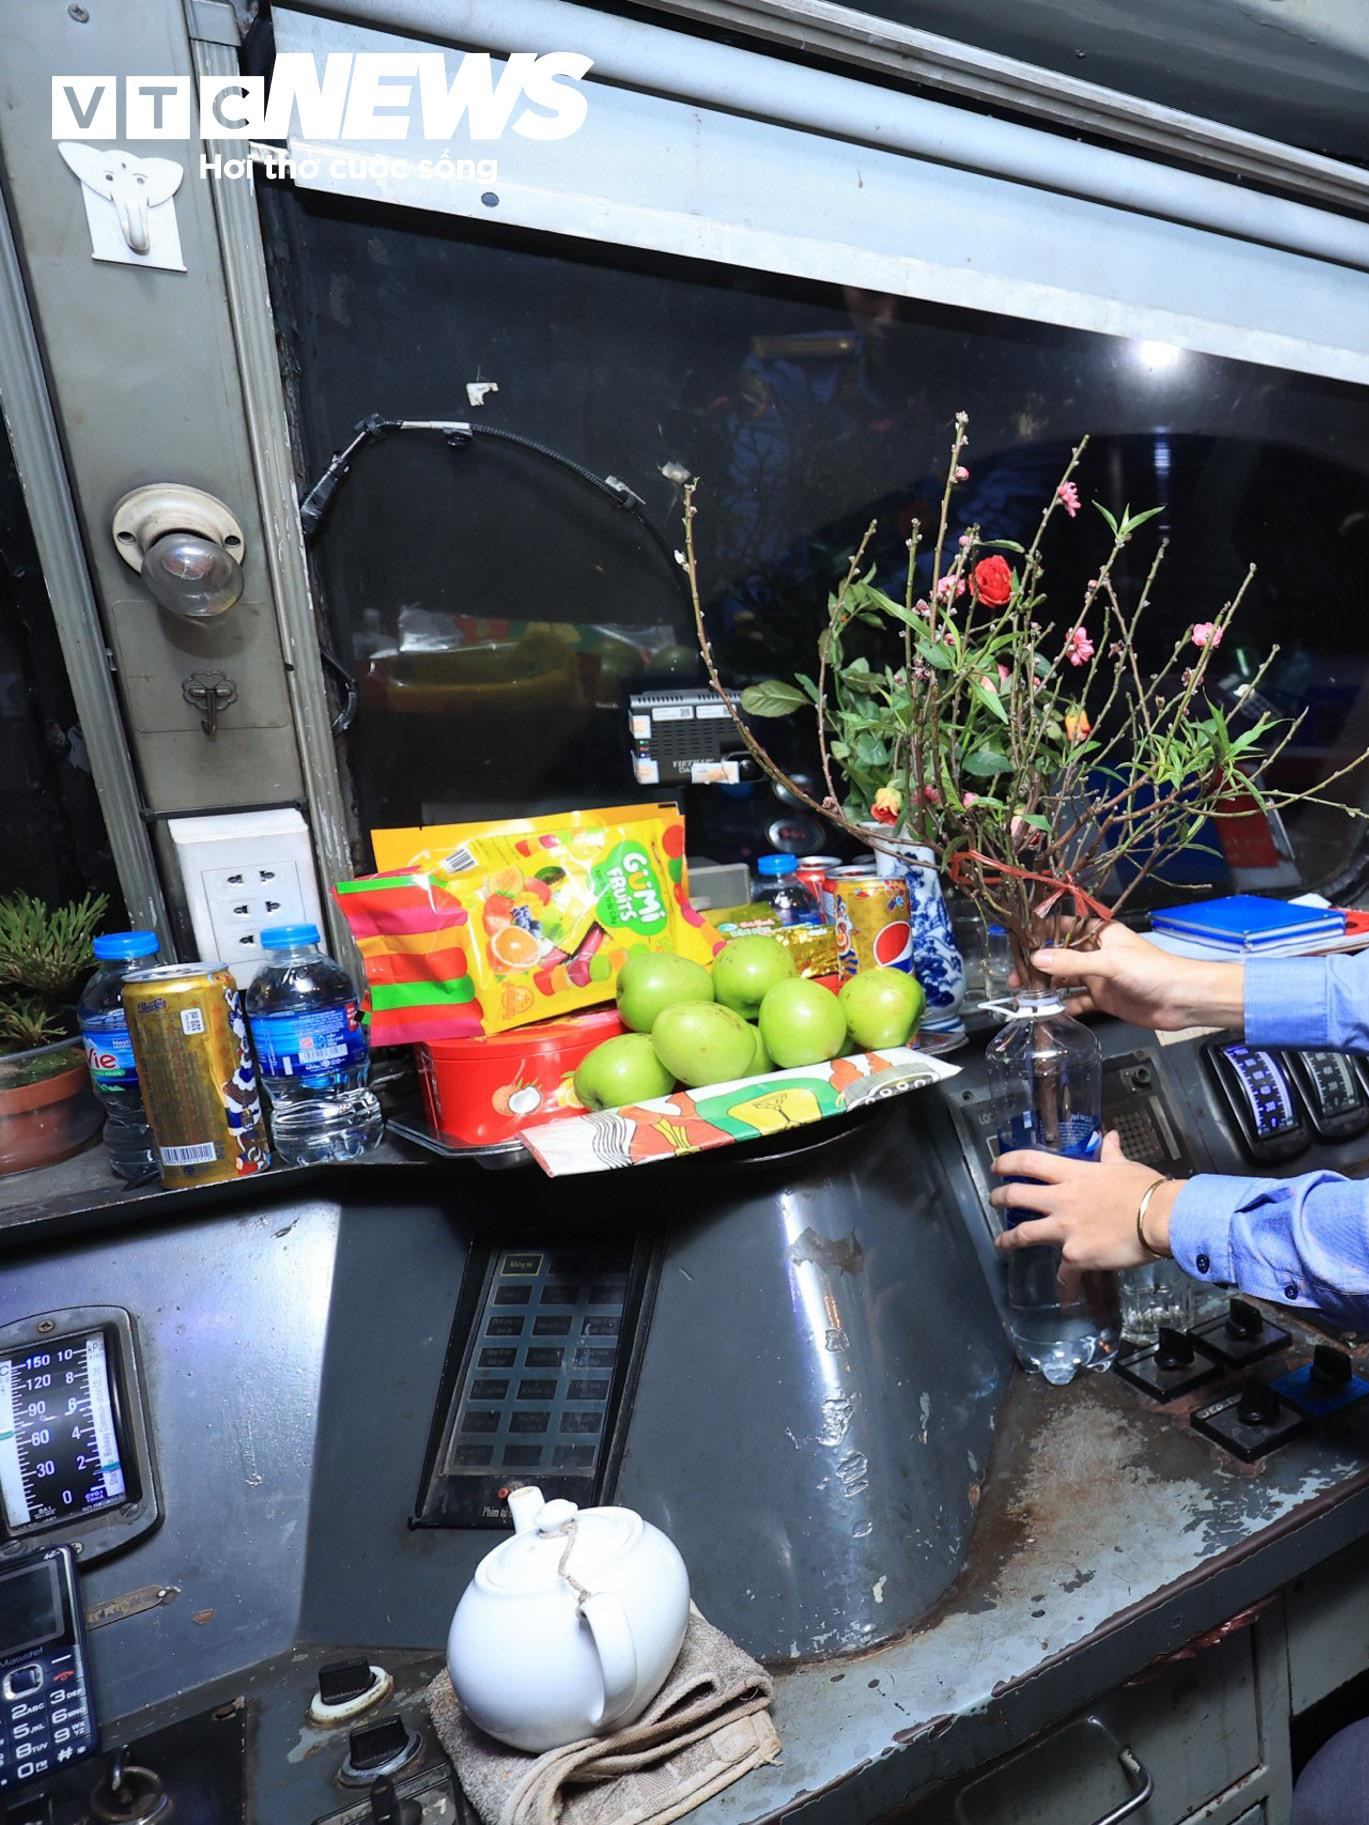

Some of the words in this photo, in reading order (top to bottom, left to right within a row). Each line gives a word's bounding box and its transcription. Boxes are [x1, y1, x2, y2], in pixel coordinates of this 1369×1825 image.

[25, 1354, 51, 1370] 150
[57, 1348, 73, 1361] 10
[26, 1374, 51, 1390] 120
[65, 1371, 74, 1384] 8
[28, 1401, 46, 1417] 90
[68, 1397, 77, 1414] 6
[31, 1429, 50, 1447] 60
[71, 1426, 81, 1440] 4
[36, 1460, 55, 1478] 30
[76, 1455, 87, 1471] 2
[62, 1489, 73, 1504] 0
